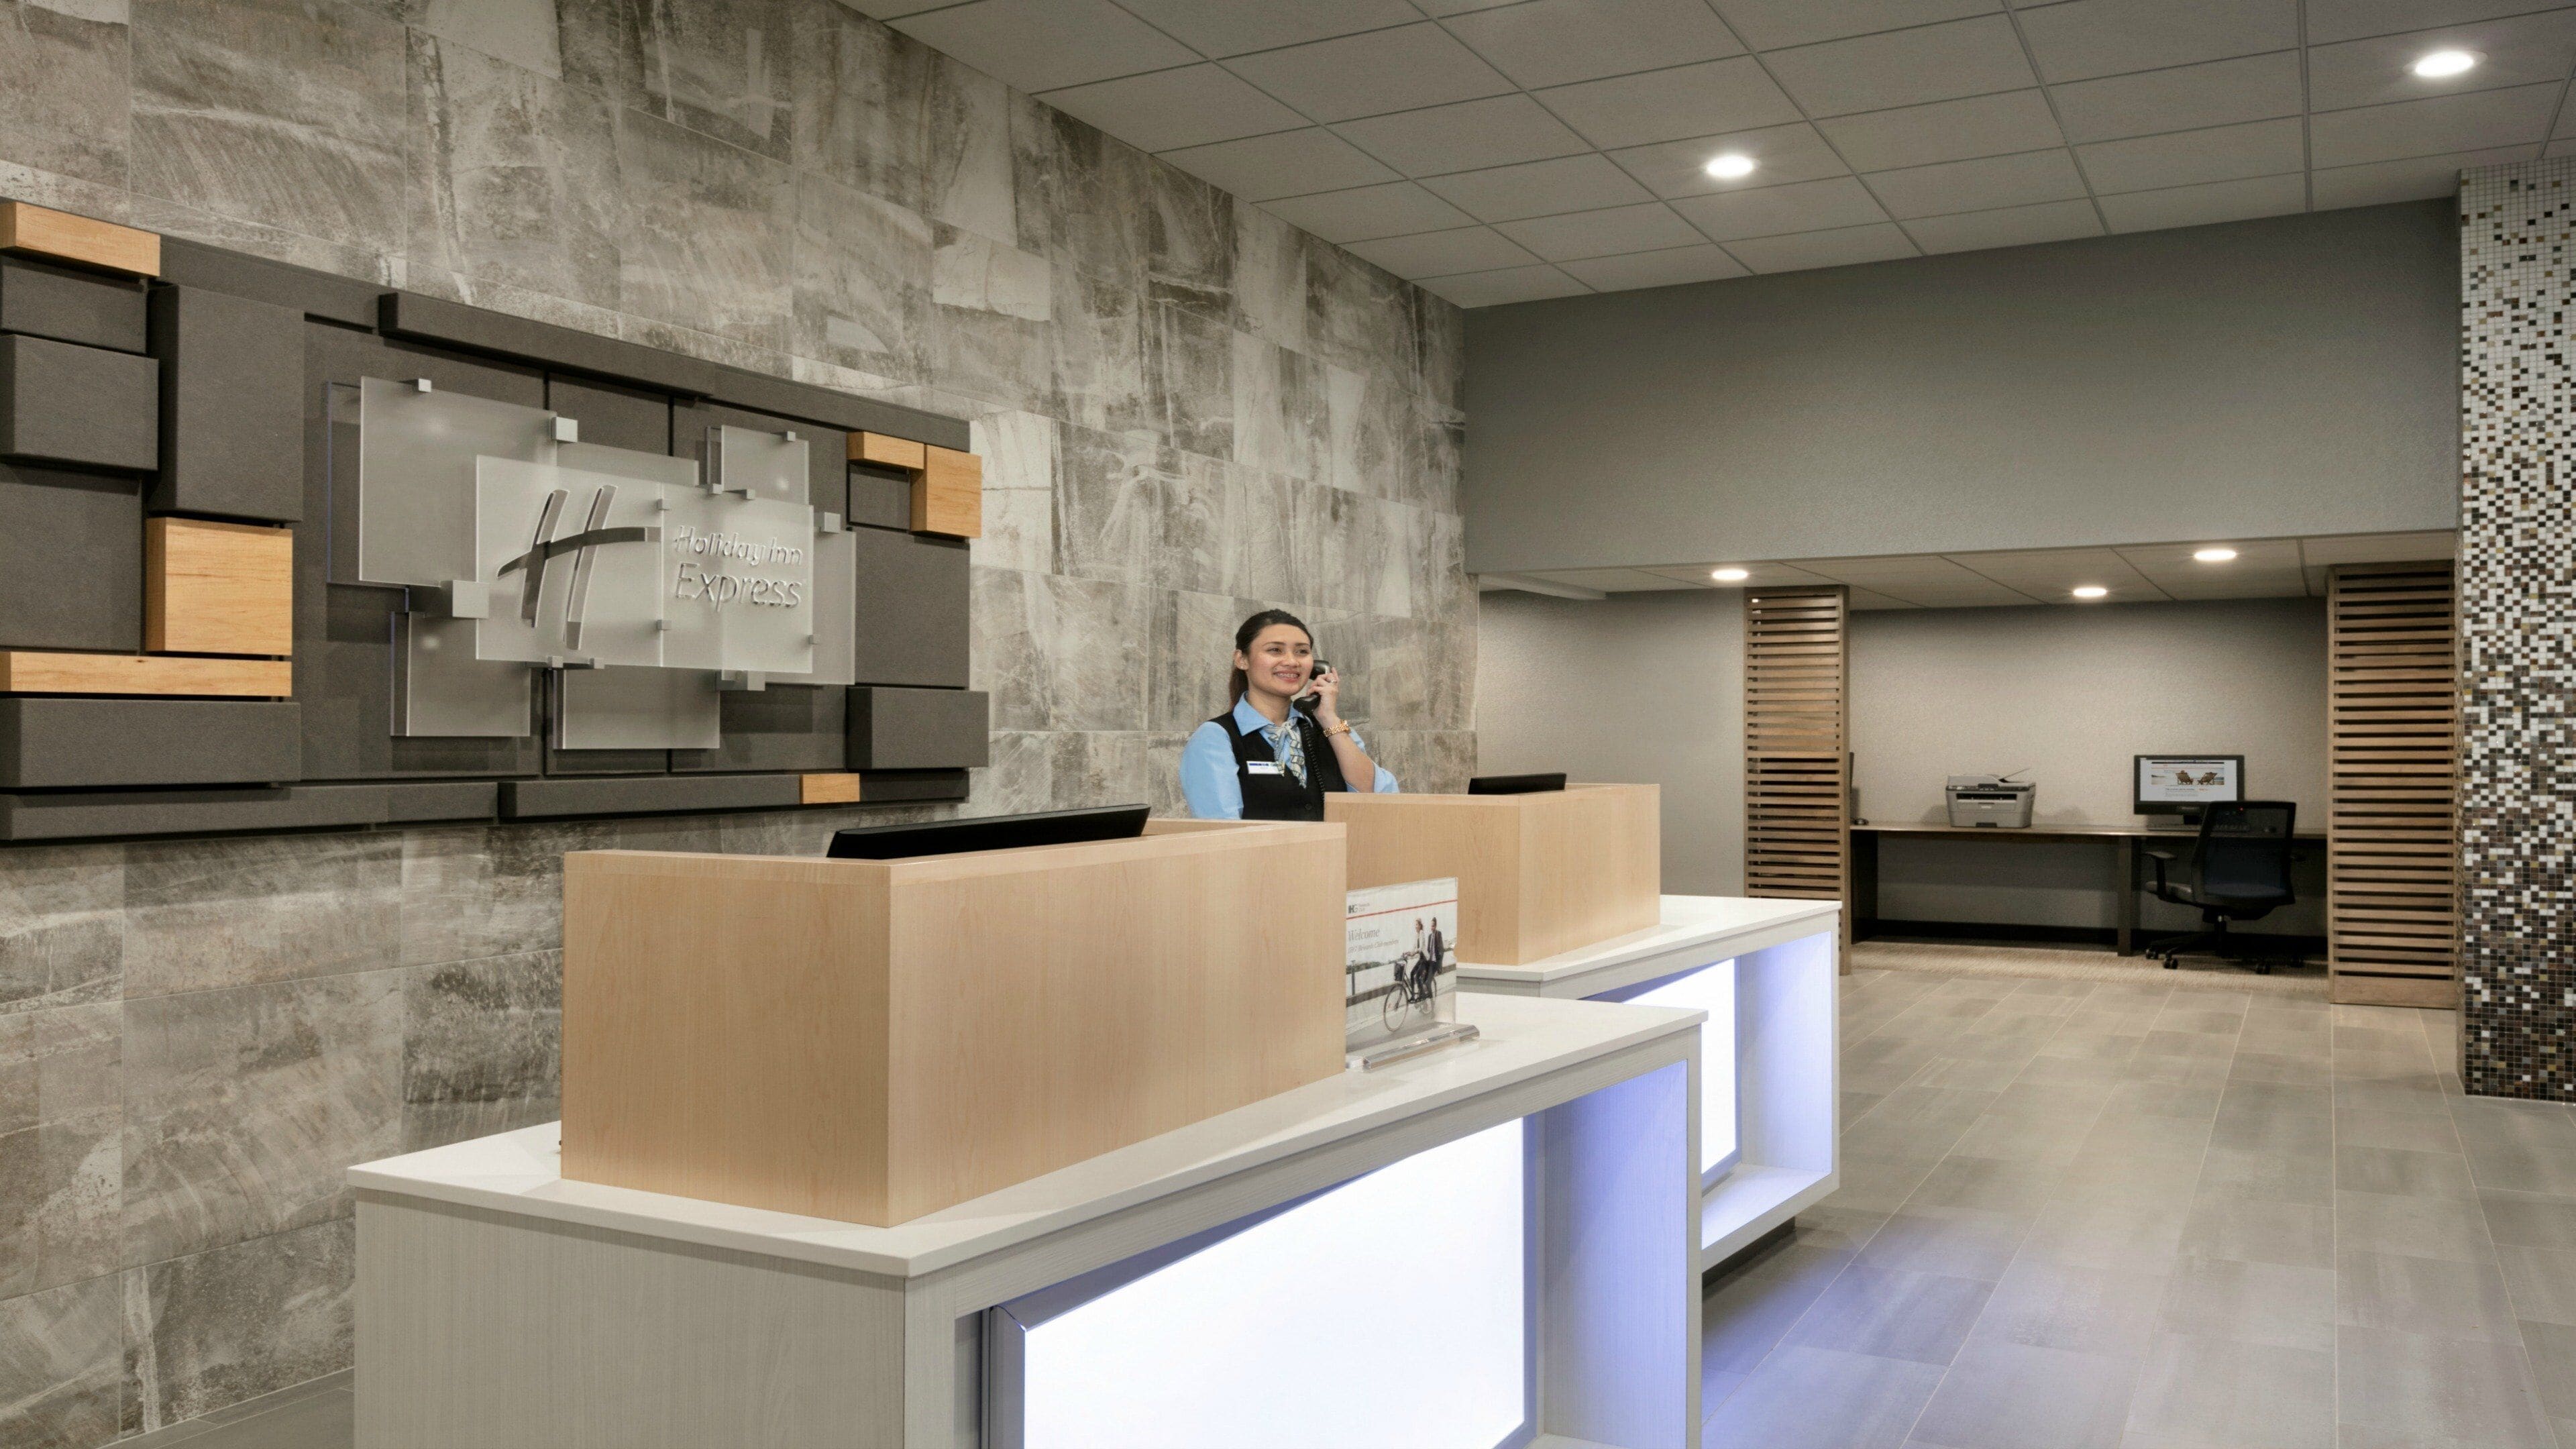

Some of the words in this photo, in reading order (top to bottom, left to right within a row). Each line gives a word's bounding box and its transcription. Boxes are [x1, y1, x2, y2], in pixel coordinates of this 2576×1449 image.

[674, 525, 765, 566] Holiday
[769, 537, 803, 566] Inn
[675, 561, 802, 612] Express
[1348, 928, 1380, 941] Welcome
